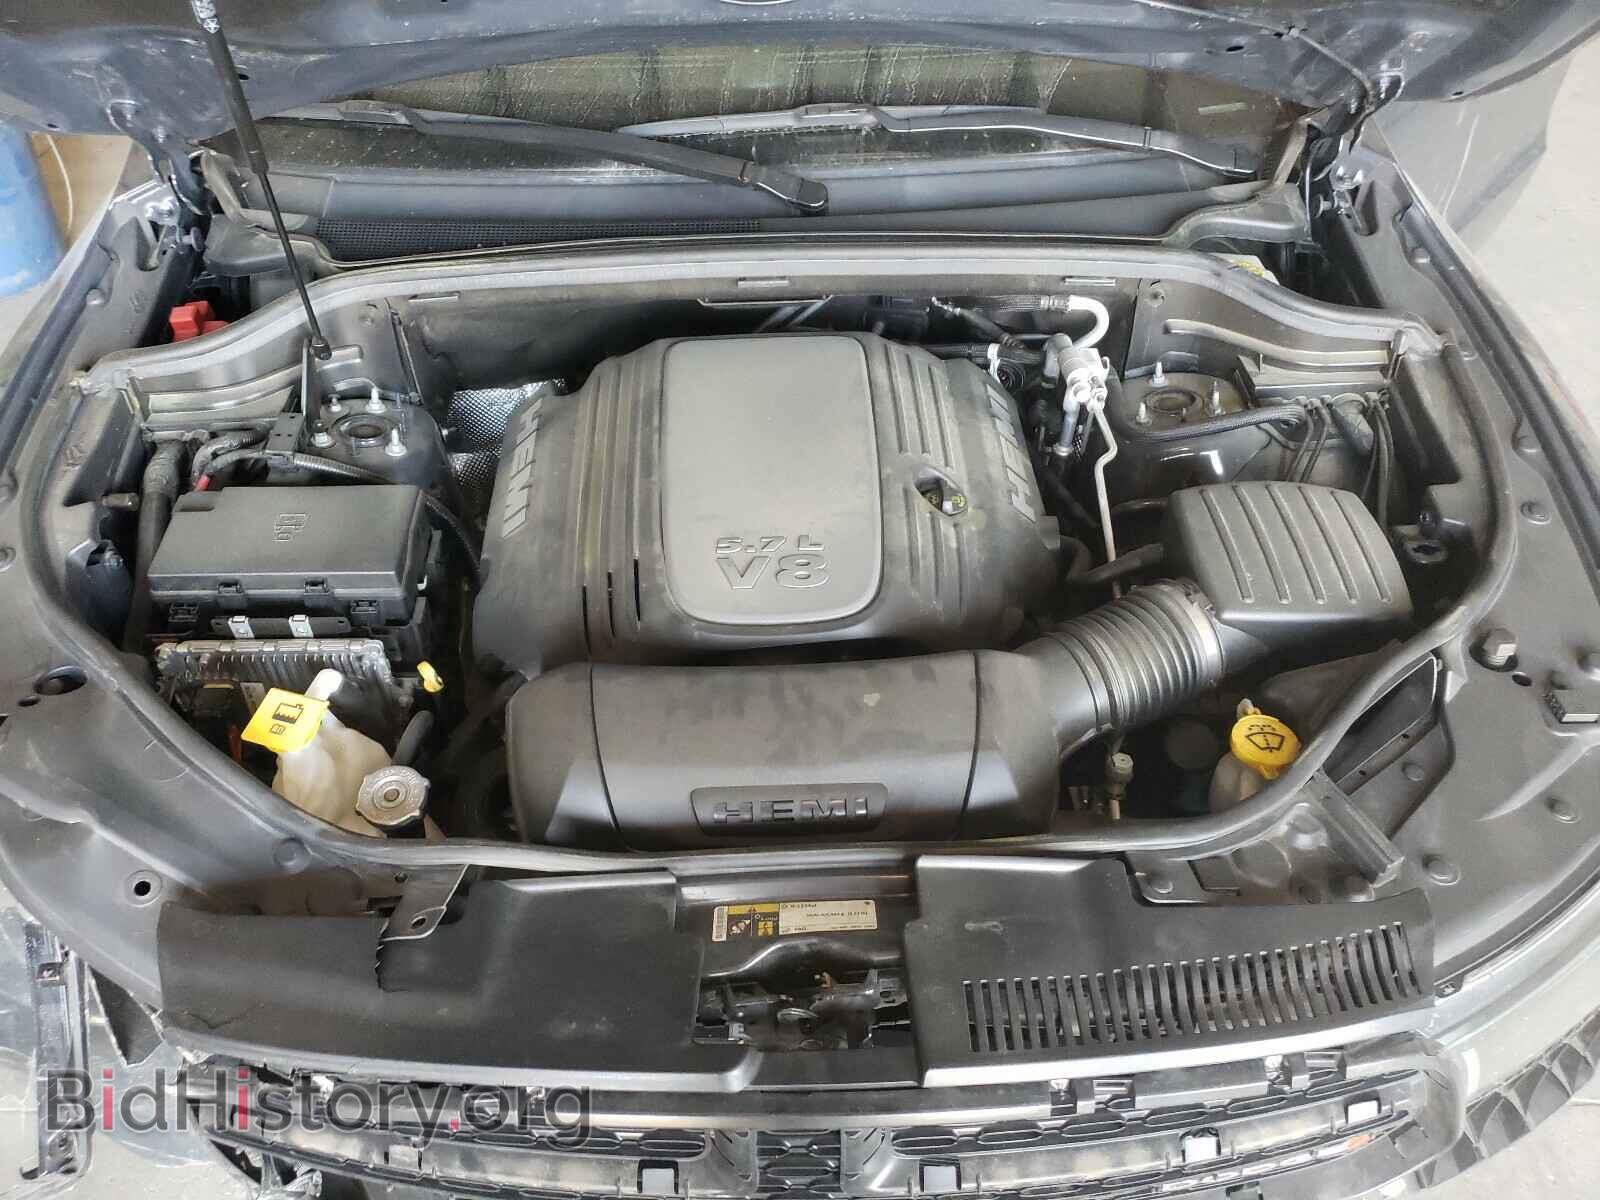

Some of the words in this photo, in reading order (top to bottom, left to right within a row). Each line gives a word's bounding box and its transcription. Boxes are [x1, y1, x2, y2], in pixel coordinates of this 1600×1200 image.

[503, 399, 542, 538] HEMI
[986, 383, 1037, 523] HEMI
[715, 536, 787, 554] 5.7
[797, 533, 825, 551] L
[715, 553, 831, 590] V8
[713, 797, 868, 824] HEMI
